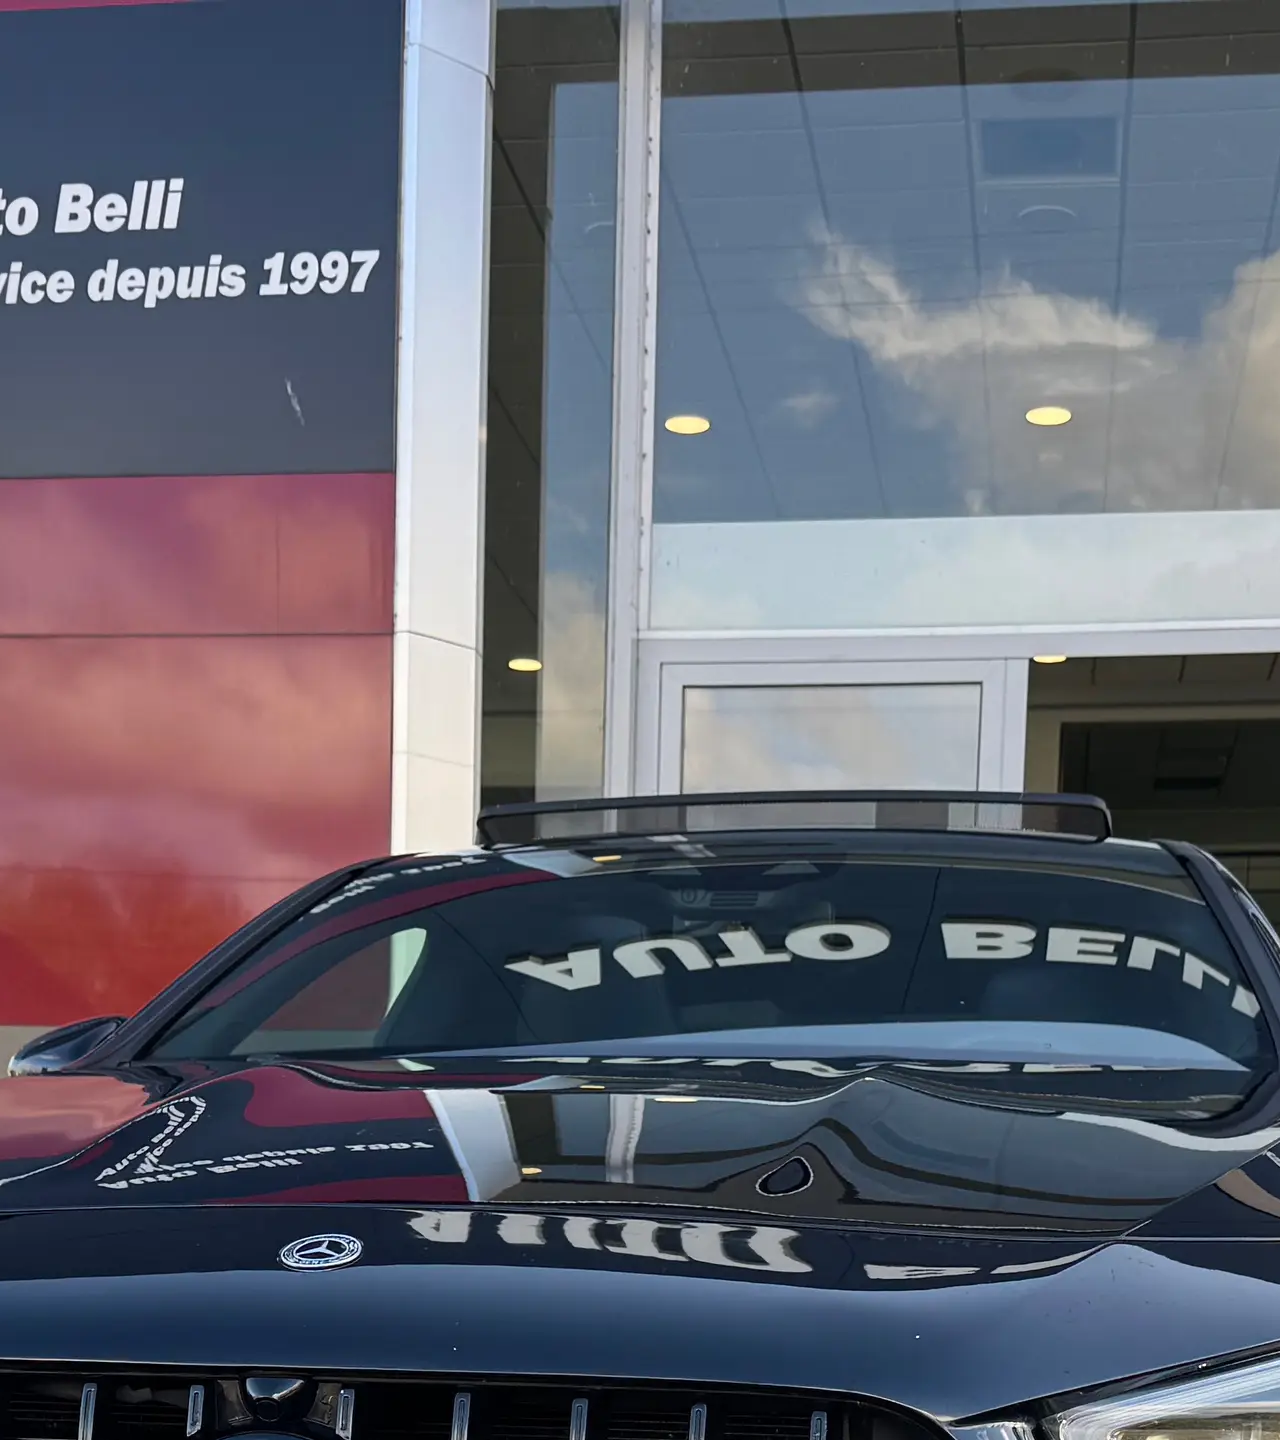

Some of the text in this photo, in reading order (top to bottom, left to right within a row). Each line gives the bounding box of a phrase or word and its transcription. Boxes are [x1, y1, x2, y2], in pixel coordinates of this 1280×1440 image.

[54, 177, 184, 234] Belli
[87, 254, 246, 309] depuis
[259, 249, 380, 296] 1997
